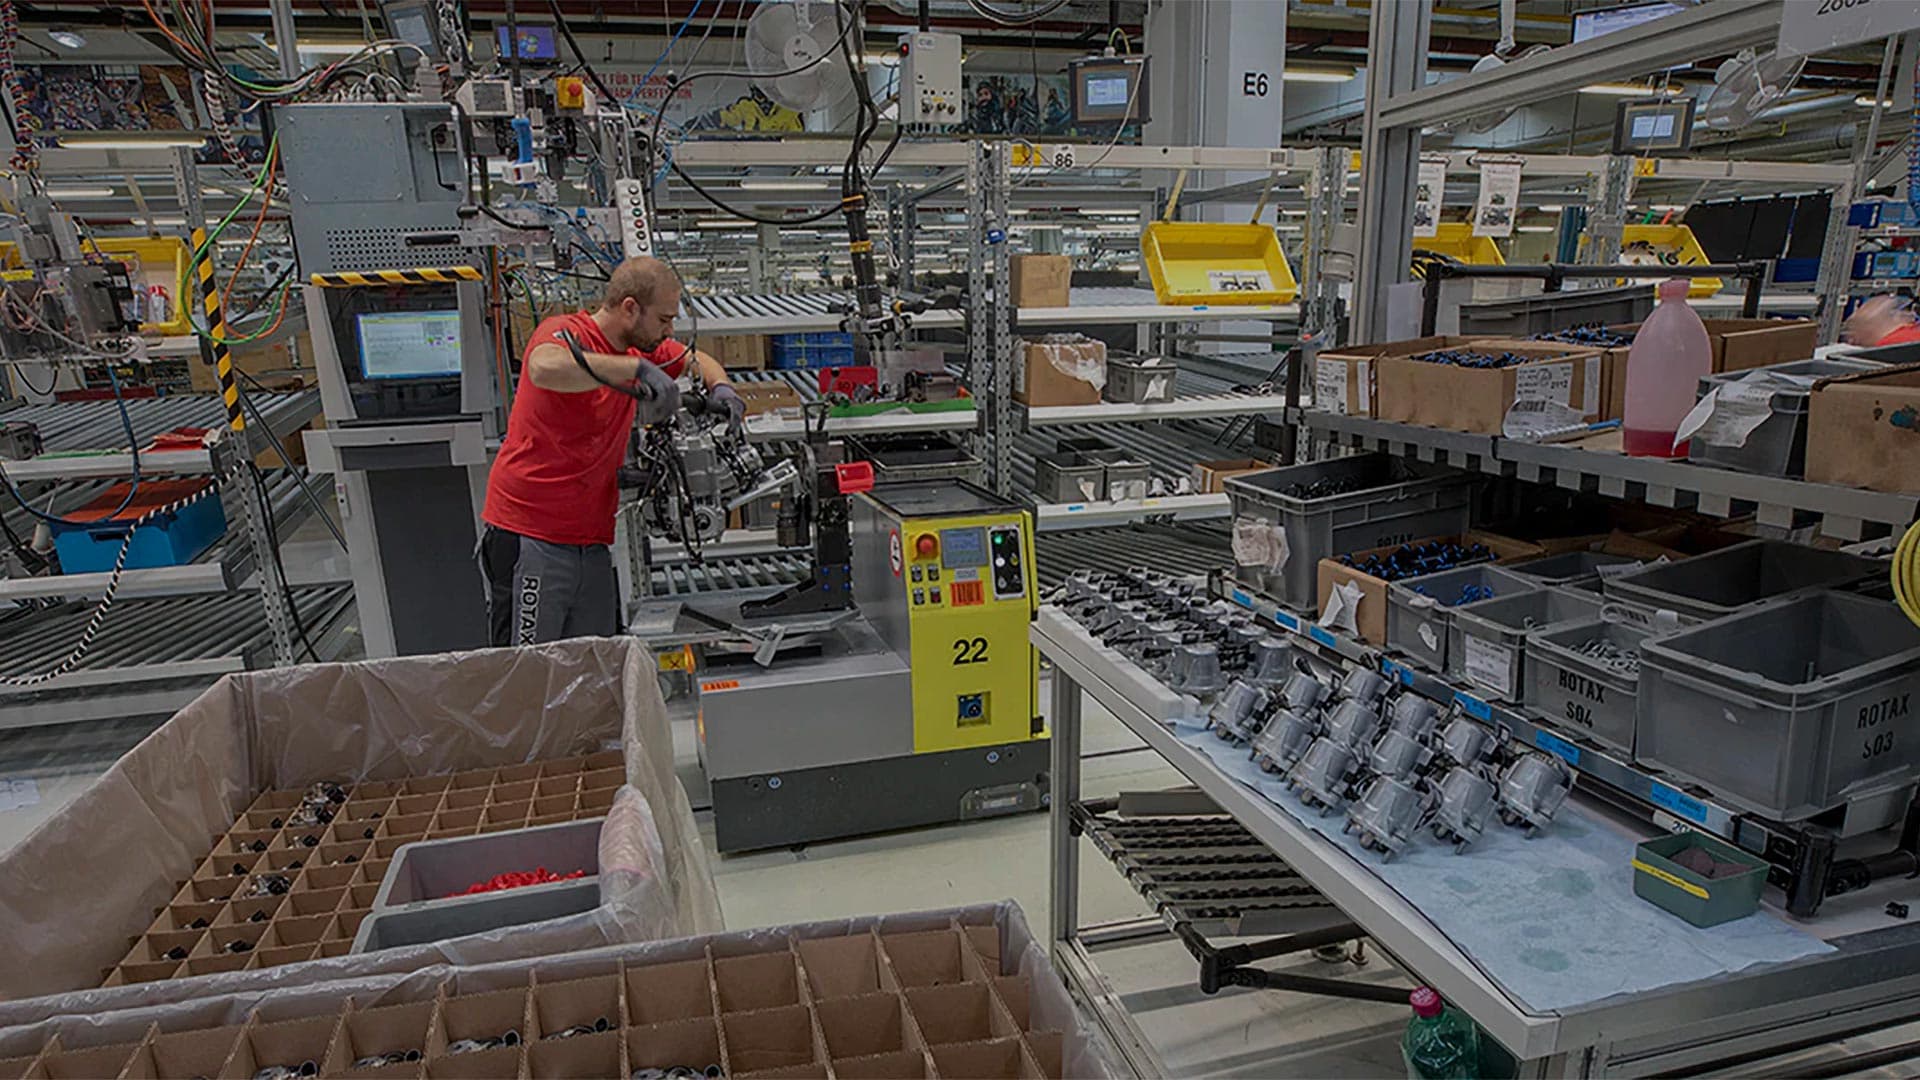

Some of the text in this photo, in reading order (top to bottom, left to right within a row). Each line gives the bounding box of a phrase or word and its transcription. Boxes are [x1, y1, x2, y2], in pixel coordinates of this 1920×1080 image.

[1243, 72, 1269, 96] E6
[1055, 153, 1073, 168] 86
[519, 576, 539, 646] ROTAX
[953, 637, 989, 665] 22
[1559, 669, 1606, 704] ROTAX
[1566, 700, 1593, 728] S04
[1857, 693, 1911, 728] ROTAX
[1862, 731, 1894, 759] S03
